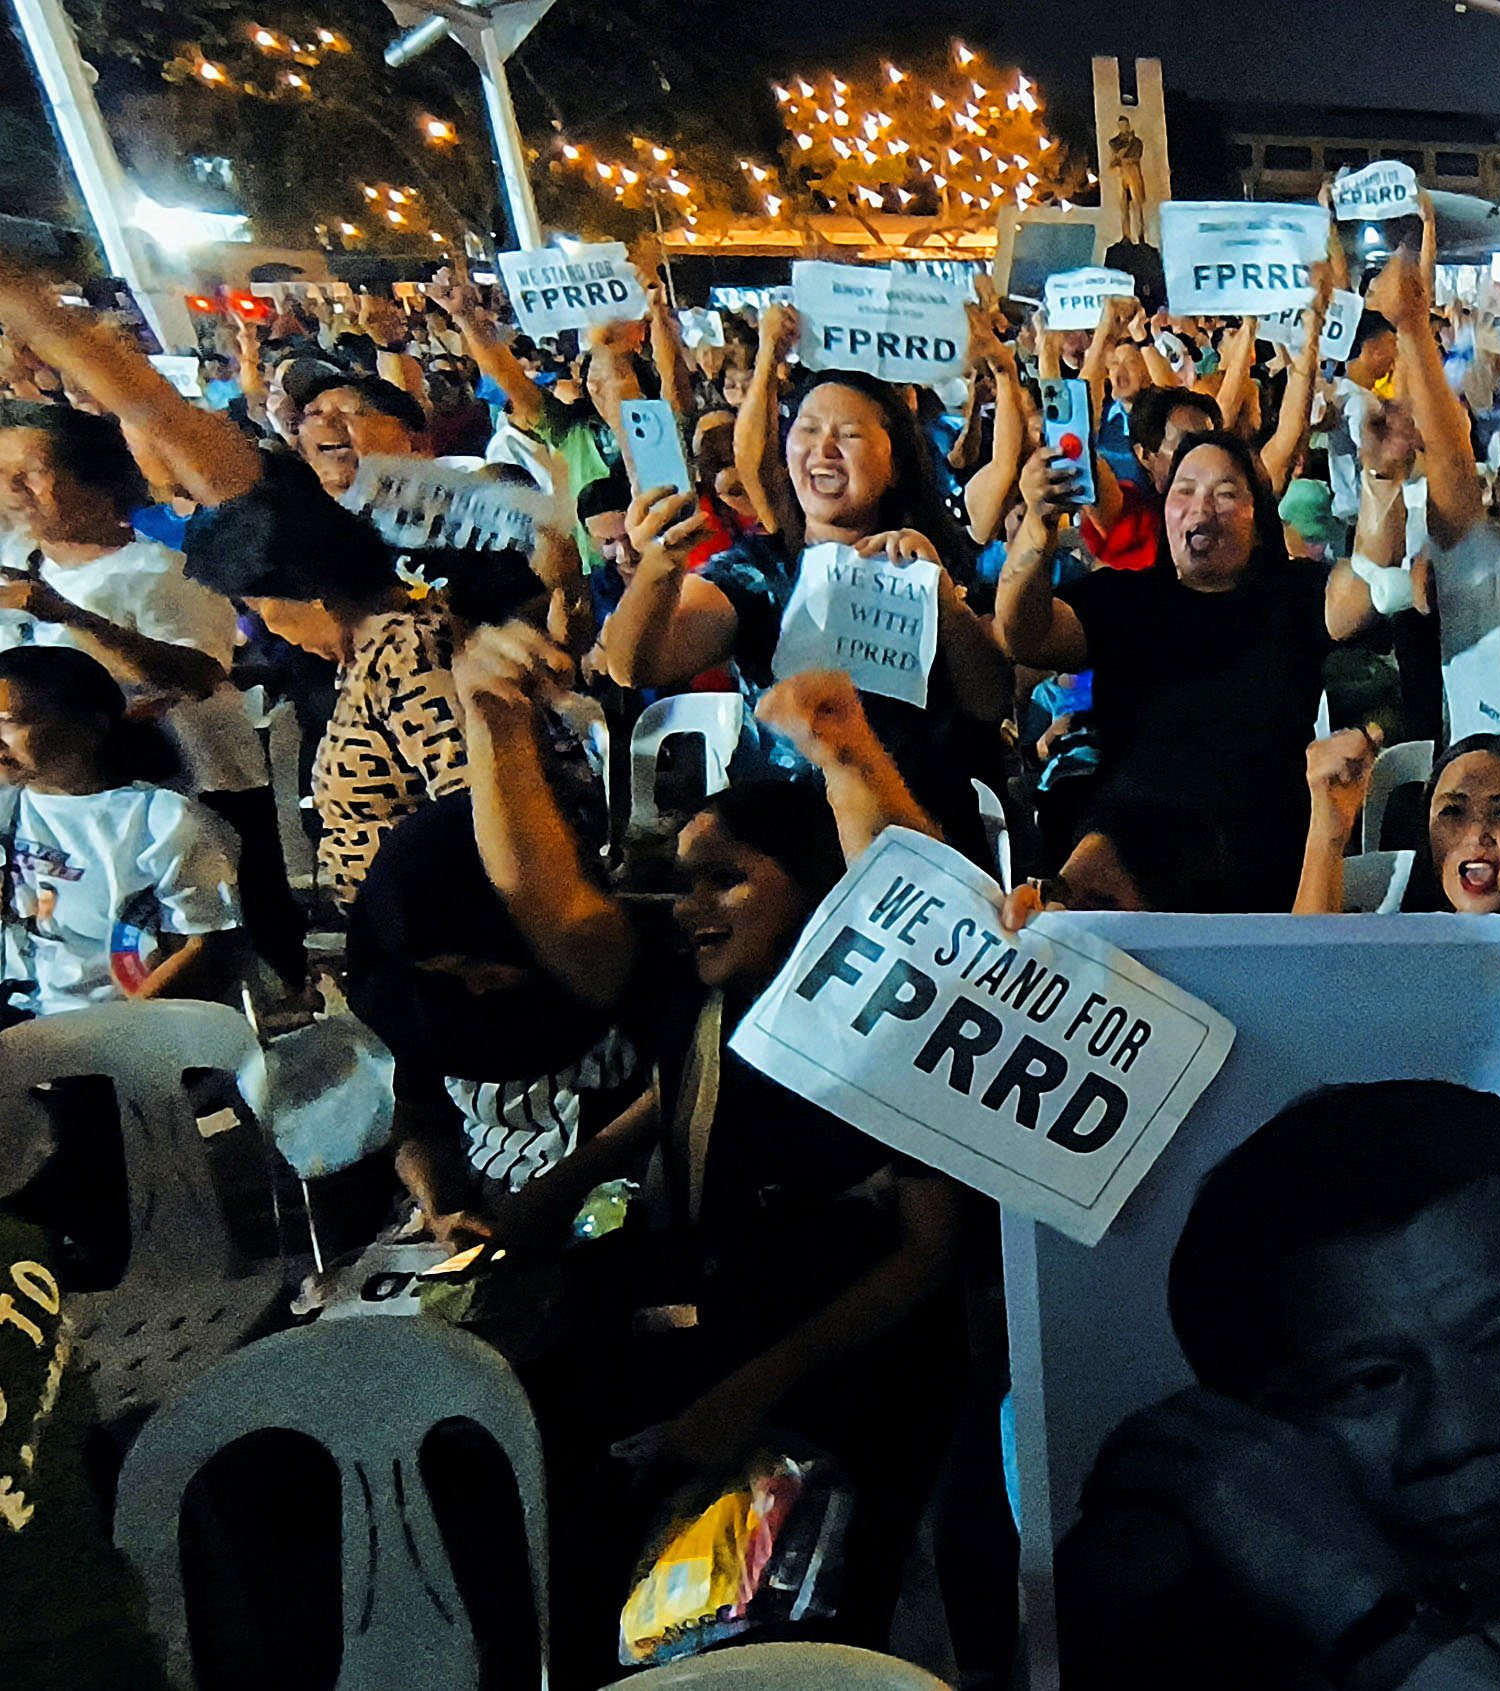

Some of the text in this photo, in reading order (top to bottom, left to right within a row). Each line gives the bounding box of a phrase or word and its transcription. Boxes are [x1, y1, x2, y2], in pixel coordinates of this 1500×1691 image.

[517, 259, 615, 287] WE STAND FOR
[1193, 263, 1311, 291] FPRRD
[521, 279, 629, 313] FPRRD
[824, 326, 956, 363] FPRRD
[826, 564, 929, 602] WE STAN
[851, 602, 921, 638] WITH
[837, 636, 921, 672] FPRRD
[868, 875, 1152, 1074] WE STAND FOR
[794, 926, 1130, 1155] FPRRD
